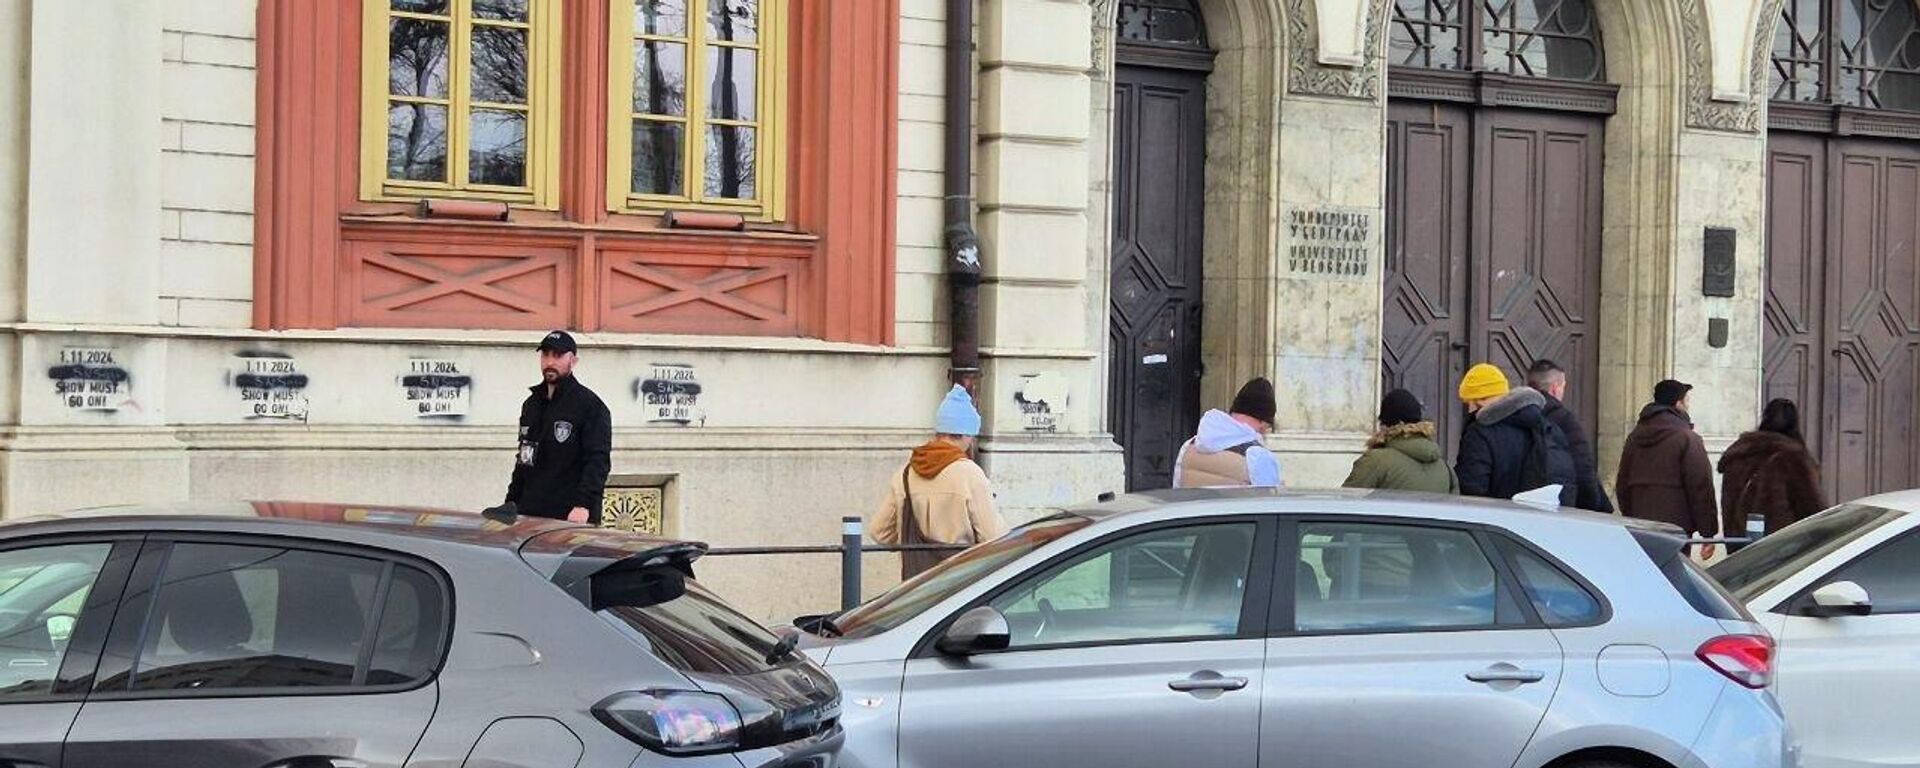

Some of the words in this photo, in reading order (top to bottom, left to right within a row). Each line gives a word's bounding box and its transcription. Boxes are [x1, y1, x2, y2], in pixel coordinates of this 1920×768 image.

[1290, 225, 1298, 237] У
[1290, 259, 1297, 272] U
[1303, 259, 1368, 276] BEOGRADU
[90, 382, 118, 394] MUST
